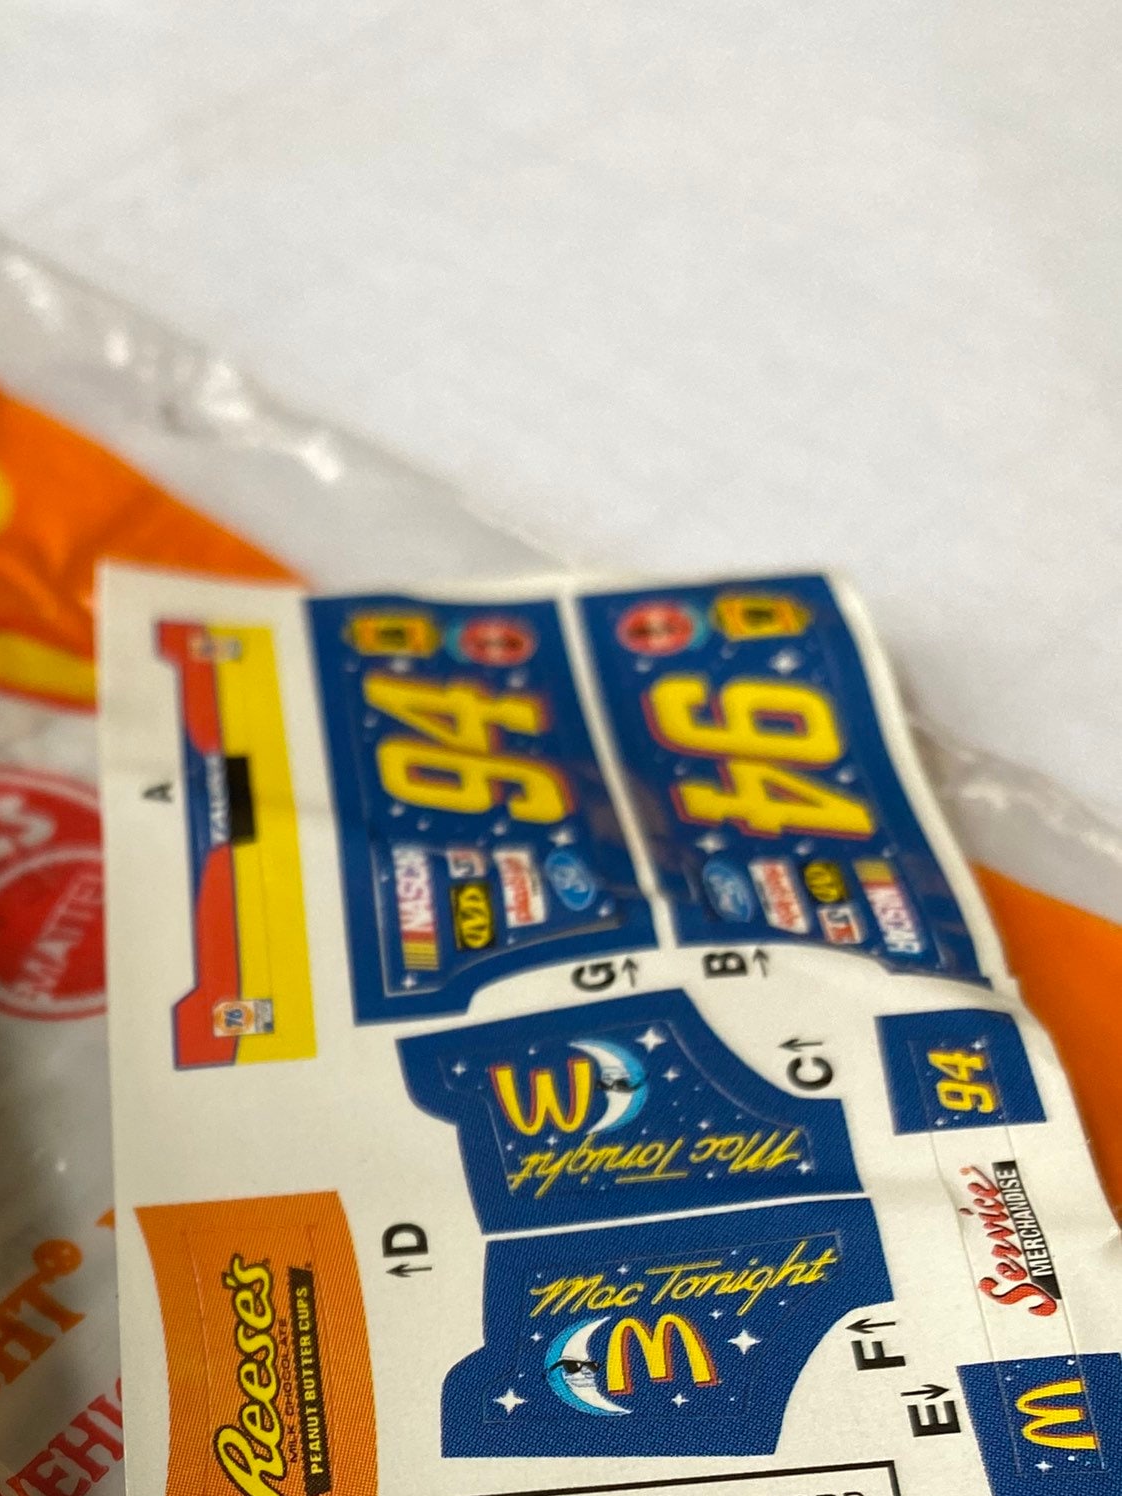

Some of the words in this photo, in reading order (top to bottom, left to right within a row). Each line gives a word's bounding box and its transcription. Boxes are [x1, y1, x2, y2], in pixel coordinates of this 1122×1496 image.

[363, 669, 571, 824] 94
[642, 673, 874, 840] 94
[142, 781, 174, 804] A
[571, 960, 616, 992] G
[702, 951, 748, 979] B
[786, 1056, 834, 1091] C
[927, 1049, 997, 1114] 94
[506, 1132, 688, 1199] Tonight
[690, 1128, 801, 1174] Mac
[382, 1223, 430, 1256] D
[959, 1165, 1059, 1317] Service
[995, 1167, 1053, 1278] MERCHANDISE
[529, 1273, 640, 1317] Mac
[647, 1240, 837, 1316] Tonight
[295, 1286, 311, 1333] CUPS
[277, 1317, 295, 1417] CHOCOLATE
[299, 1334, 318, 1402] BUTTER
[852, 1340, 906, 1371] F
[286, 1424, 298, 1464] MILK
[303, 1406, 324, 1475] PEANUT
[911, 1401, 962, 1438] E
